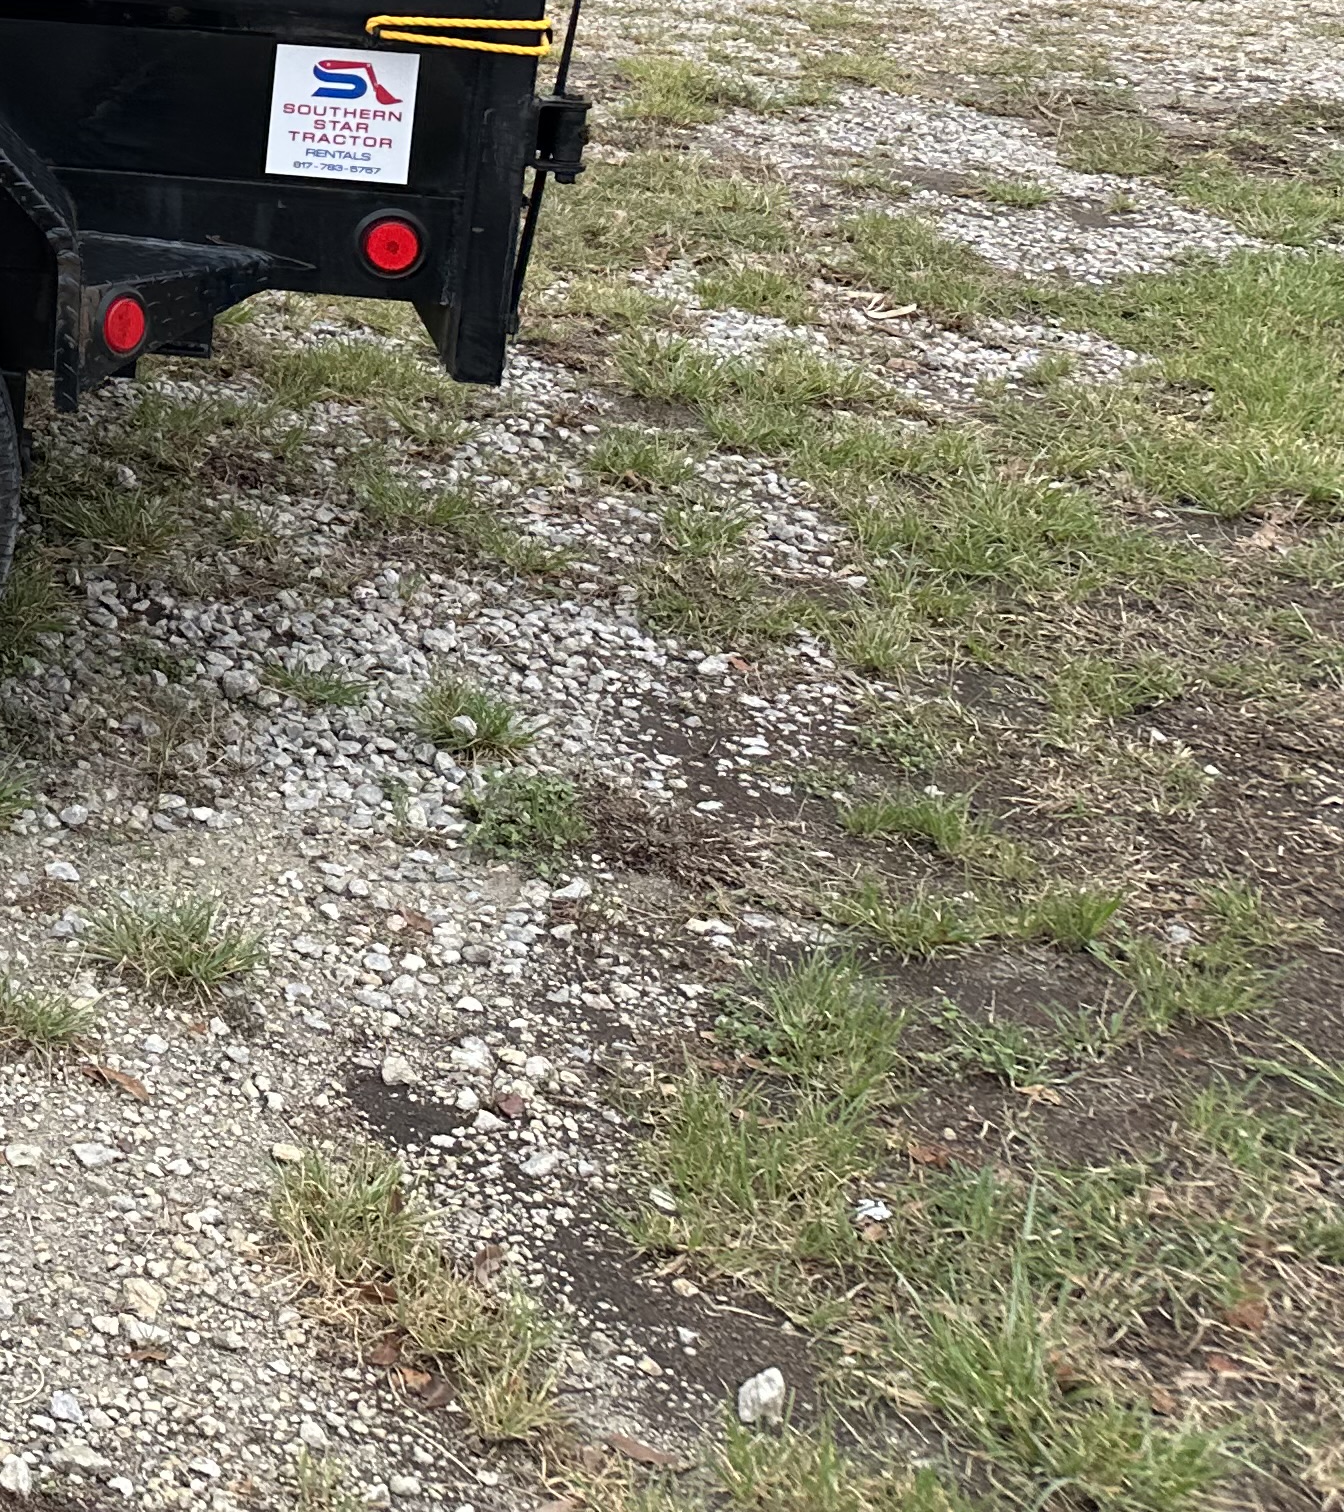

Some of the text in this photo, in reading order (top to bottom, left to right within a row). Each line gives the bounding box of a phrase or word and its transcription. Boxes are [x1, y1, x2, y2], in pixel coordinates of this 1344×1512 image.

[283, 102, 403, 123] SOUTHERN
[313, 118, 369, 134] STAR
[288, 130, 393, 149] TRACTOR
[305, 148, 372, 162] RENTALS
